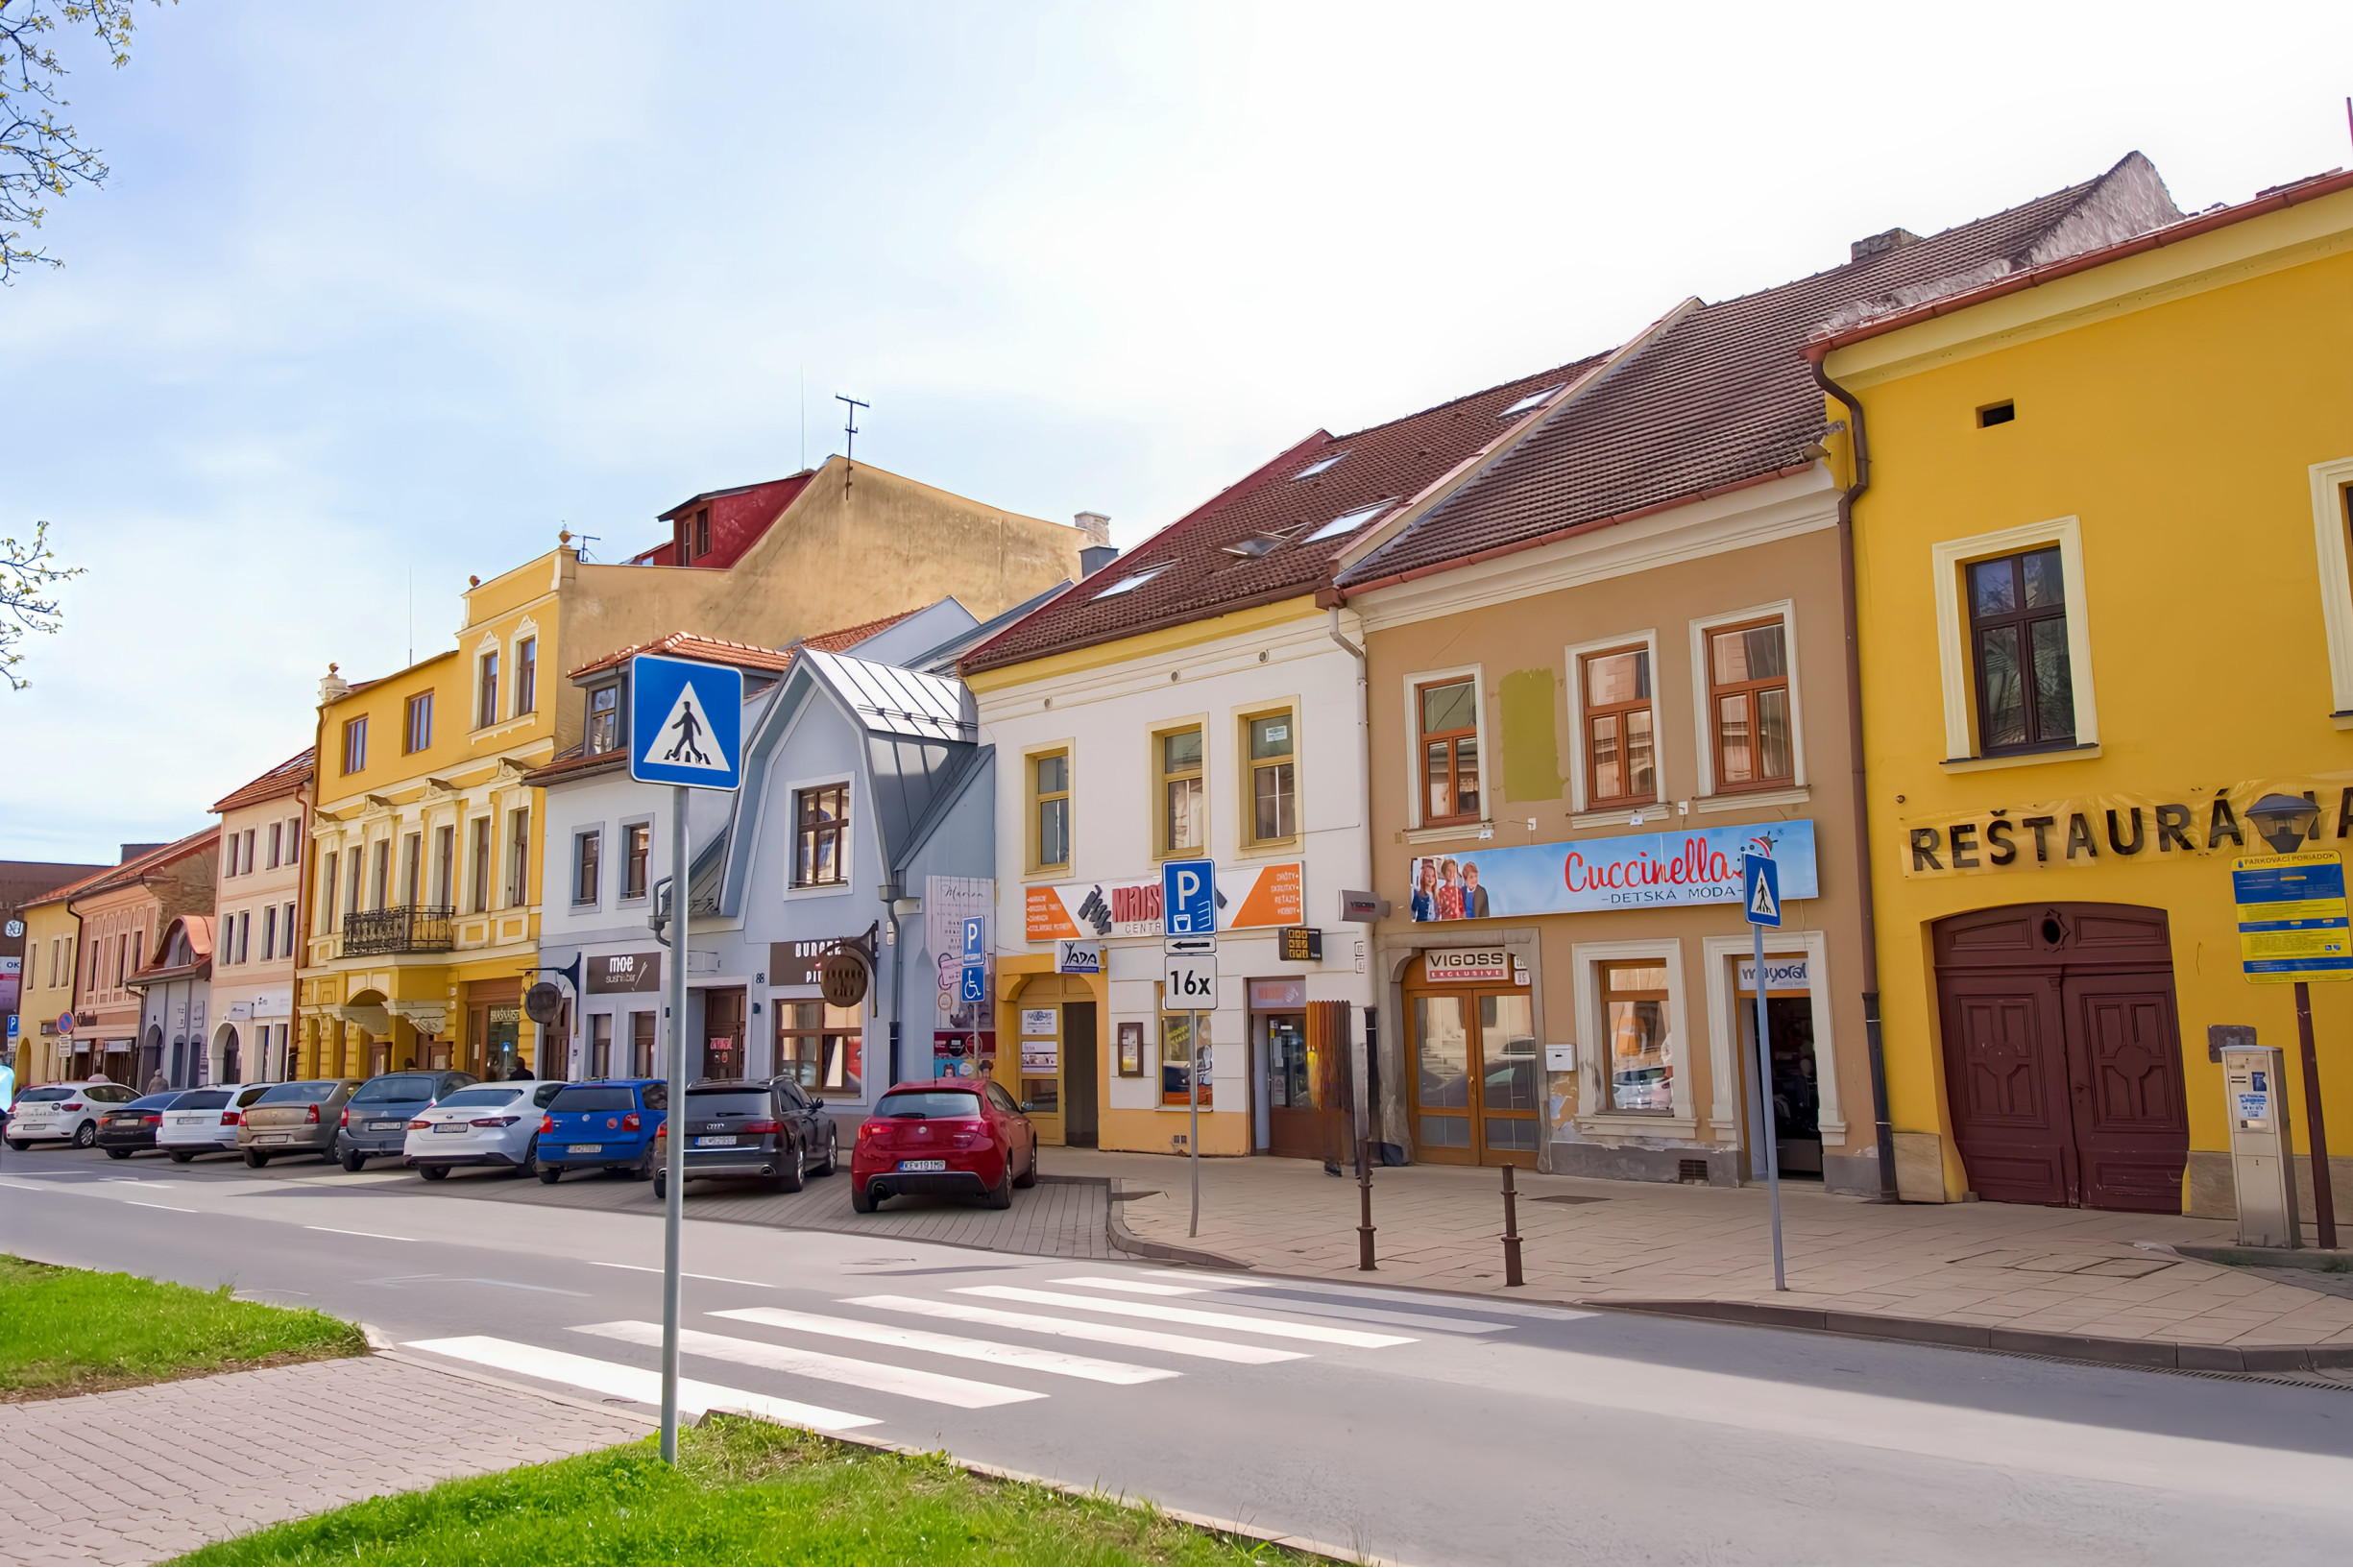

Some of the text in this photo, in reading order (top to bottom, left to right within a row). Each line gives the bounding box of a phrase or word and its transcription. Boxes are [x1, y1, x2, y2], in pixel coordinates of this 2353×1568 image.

[1909, 787, 2353, 871] REŠTAURÁI
[1565, 837, 1743, 893] Cuccinella
[2244, 853, 2335, 865] PARKOVACÍ PORIADOK
[1177, 871, 1200, 910] P
[968, 923, 978, 950] P
[1126, 922, 1161, 933] CENTR
[609, 955, 634, 973] moe
[1064, 942, 1097, 965] YADA
[1429, 953, 1504, 967] VIGOSS
[1170, 970, 1211, 996] 16x
